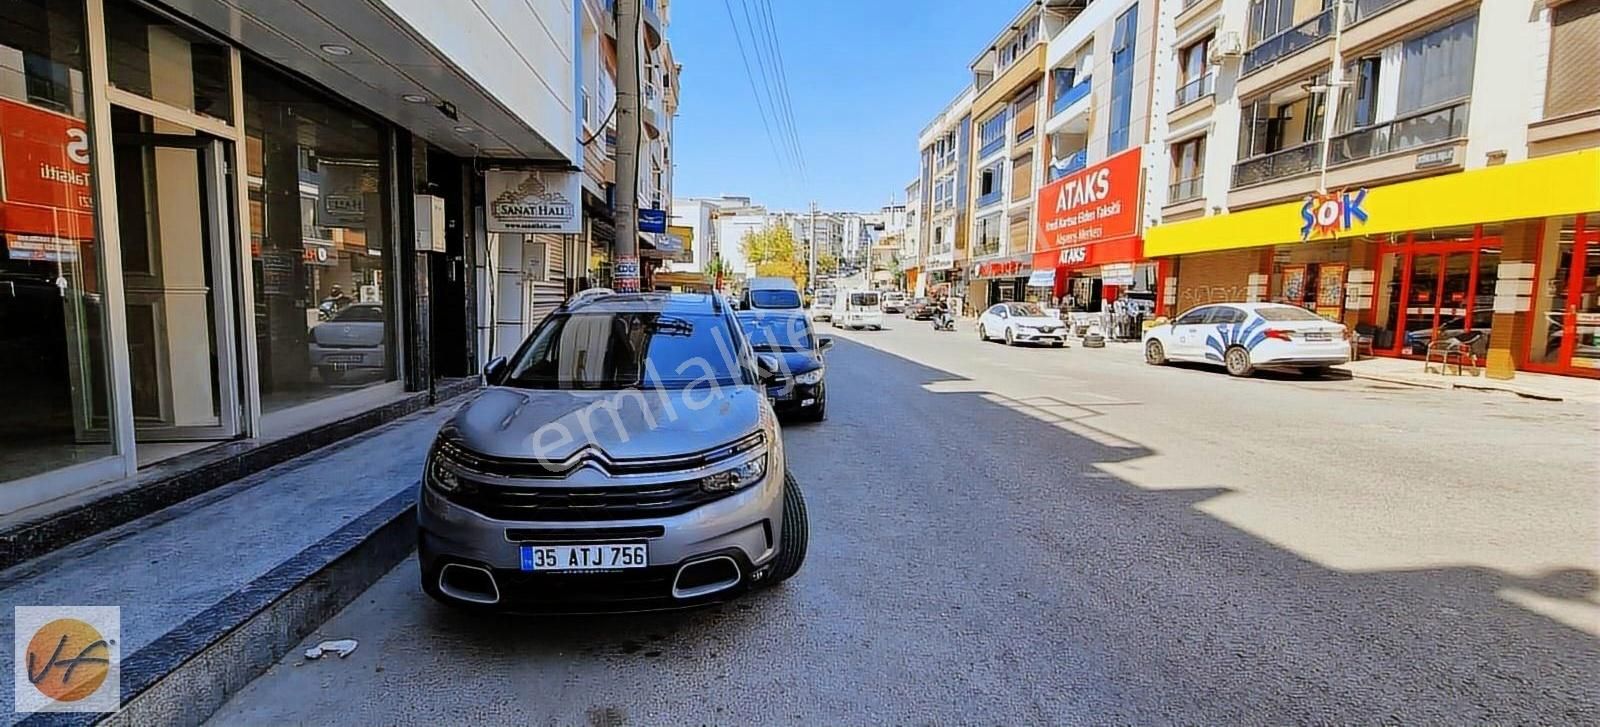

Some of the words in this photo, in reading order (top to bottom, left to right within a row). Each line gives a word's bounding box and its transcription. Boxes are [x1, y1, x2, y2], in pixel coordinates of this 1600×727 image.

[1056, 168, 1110, 213] ATAKS
[501, 205, 538, 216] SANAT
[1059, 246, 1087, 265] ATAKS
[535, 549, 556, 567] 35
[569, 548, 602, 567] ATJ
[611, 547, 644, 565] 756
